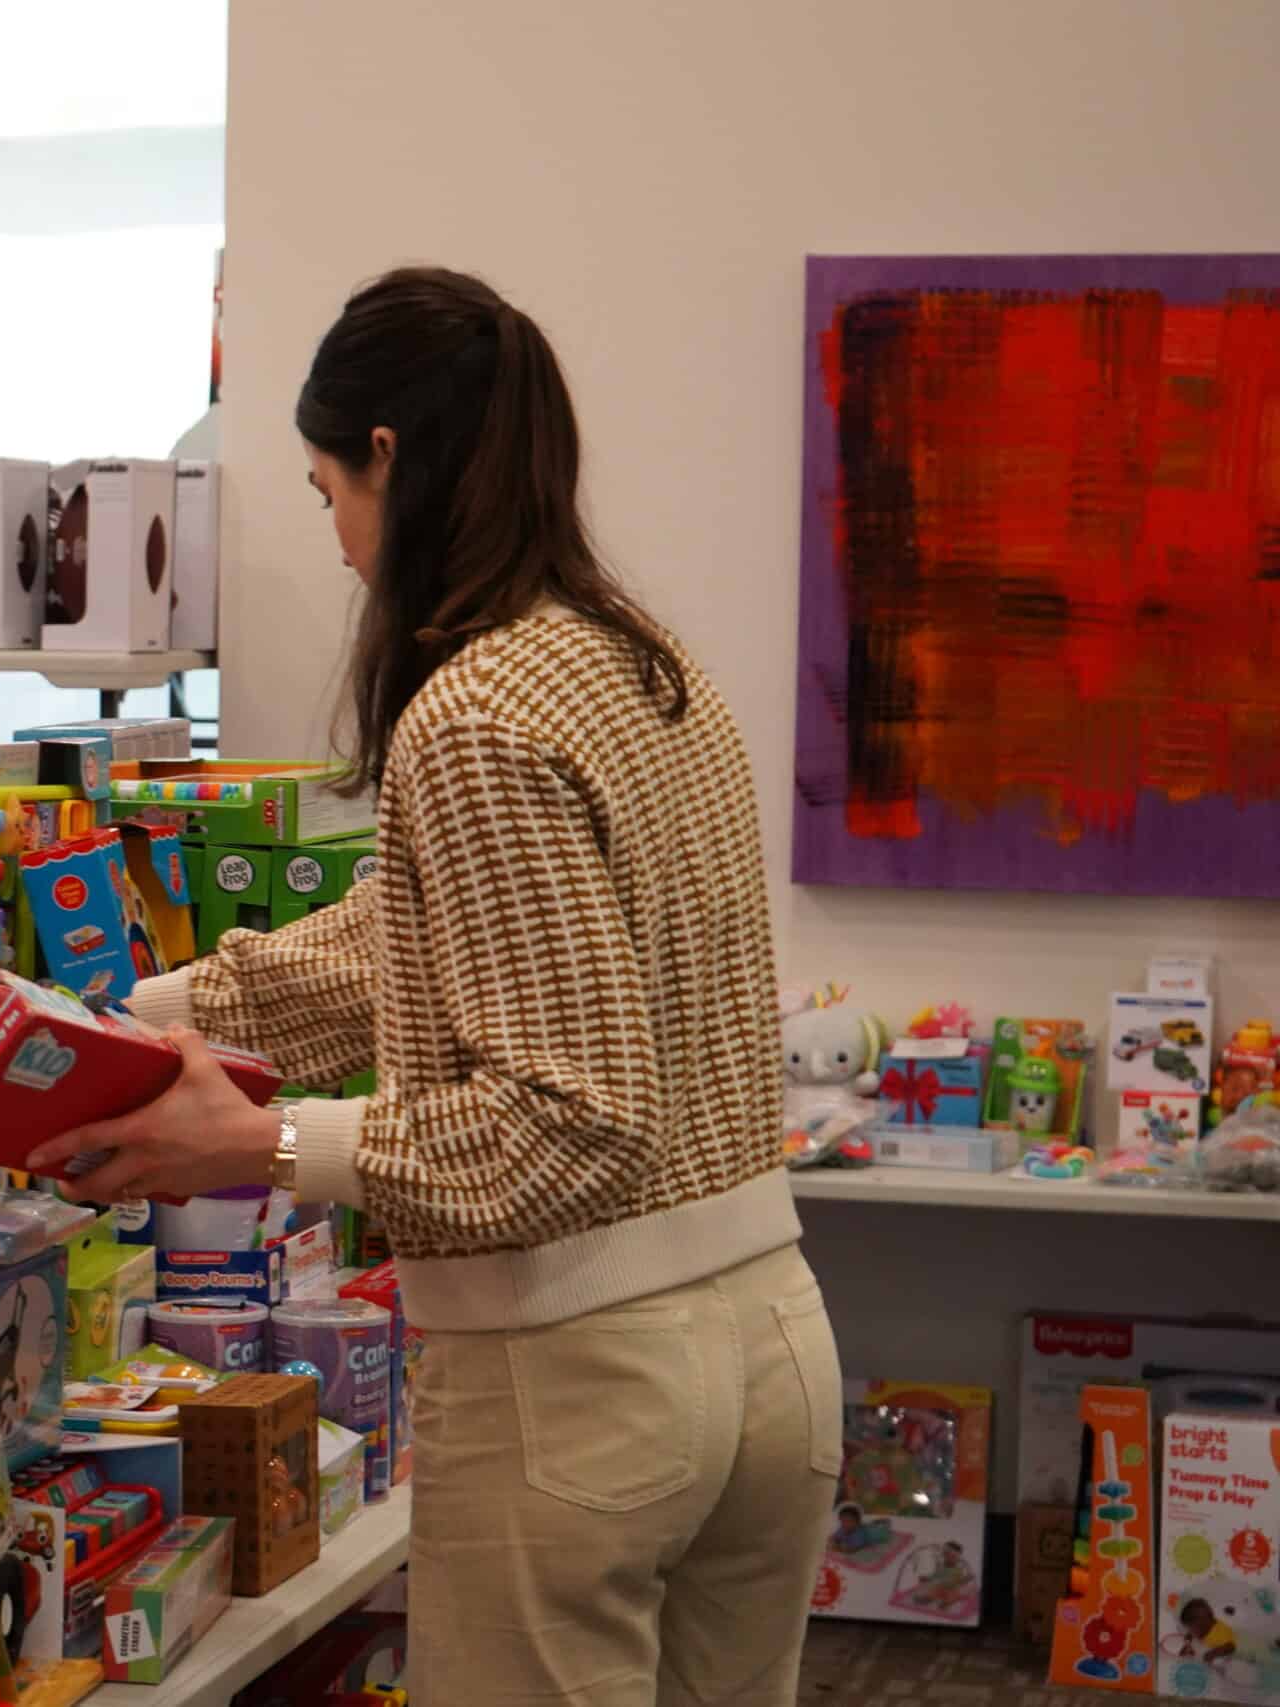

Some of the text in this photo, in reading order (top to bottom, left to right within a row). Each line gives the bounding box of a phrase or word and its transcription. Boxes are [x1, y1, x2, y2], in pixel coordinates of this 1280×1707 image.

[356, 861, 377, 878] Lea
[19, 1044, 71, 1077] KID
[1170, 1424, 1228, 1445] bright
[1170, 1443, 1228, 1462] starts
[1170, 1467, 1270, 1491] Tummy Time
[1168, 1485, 1204, 1503] Prop
[1223, 1489, 1255, 1510] Play
